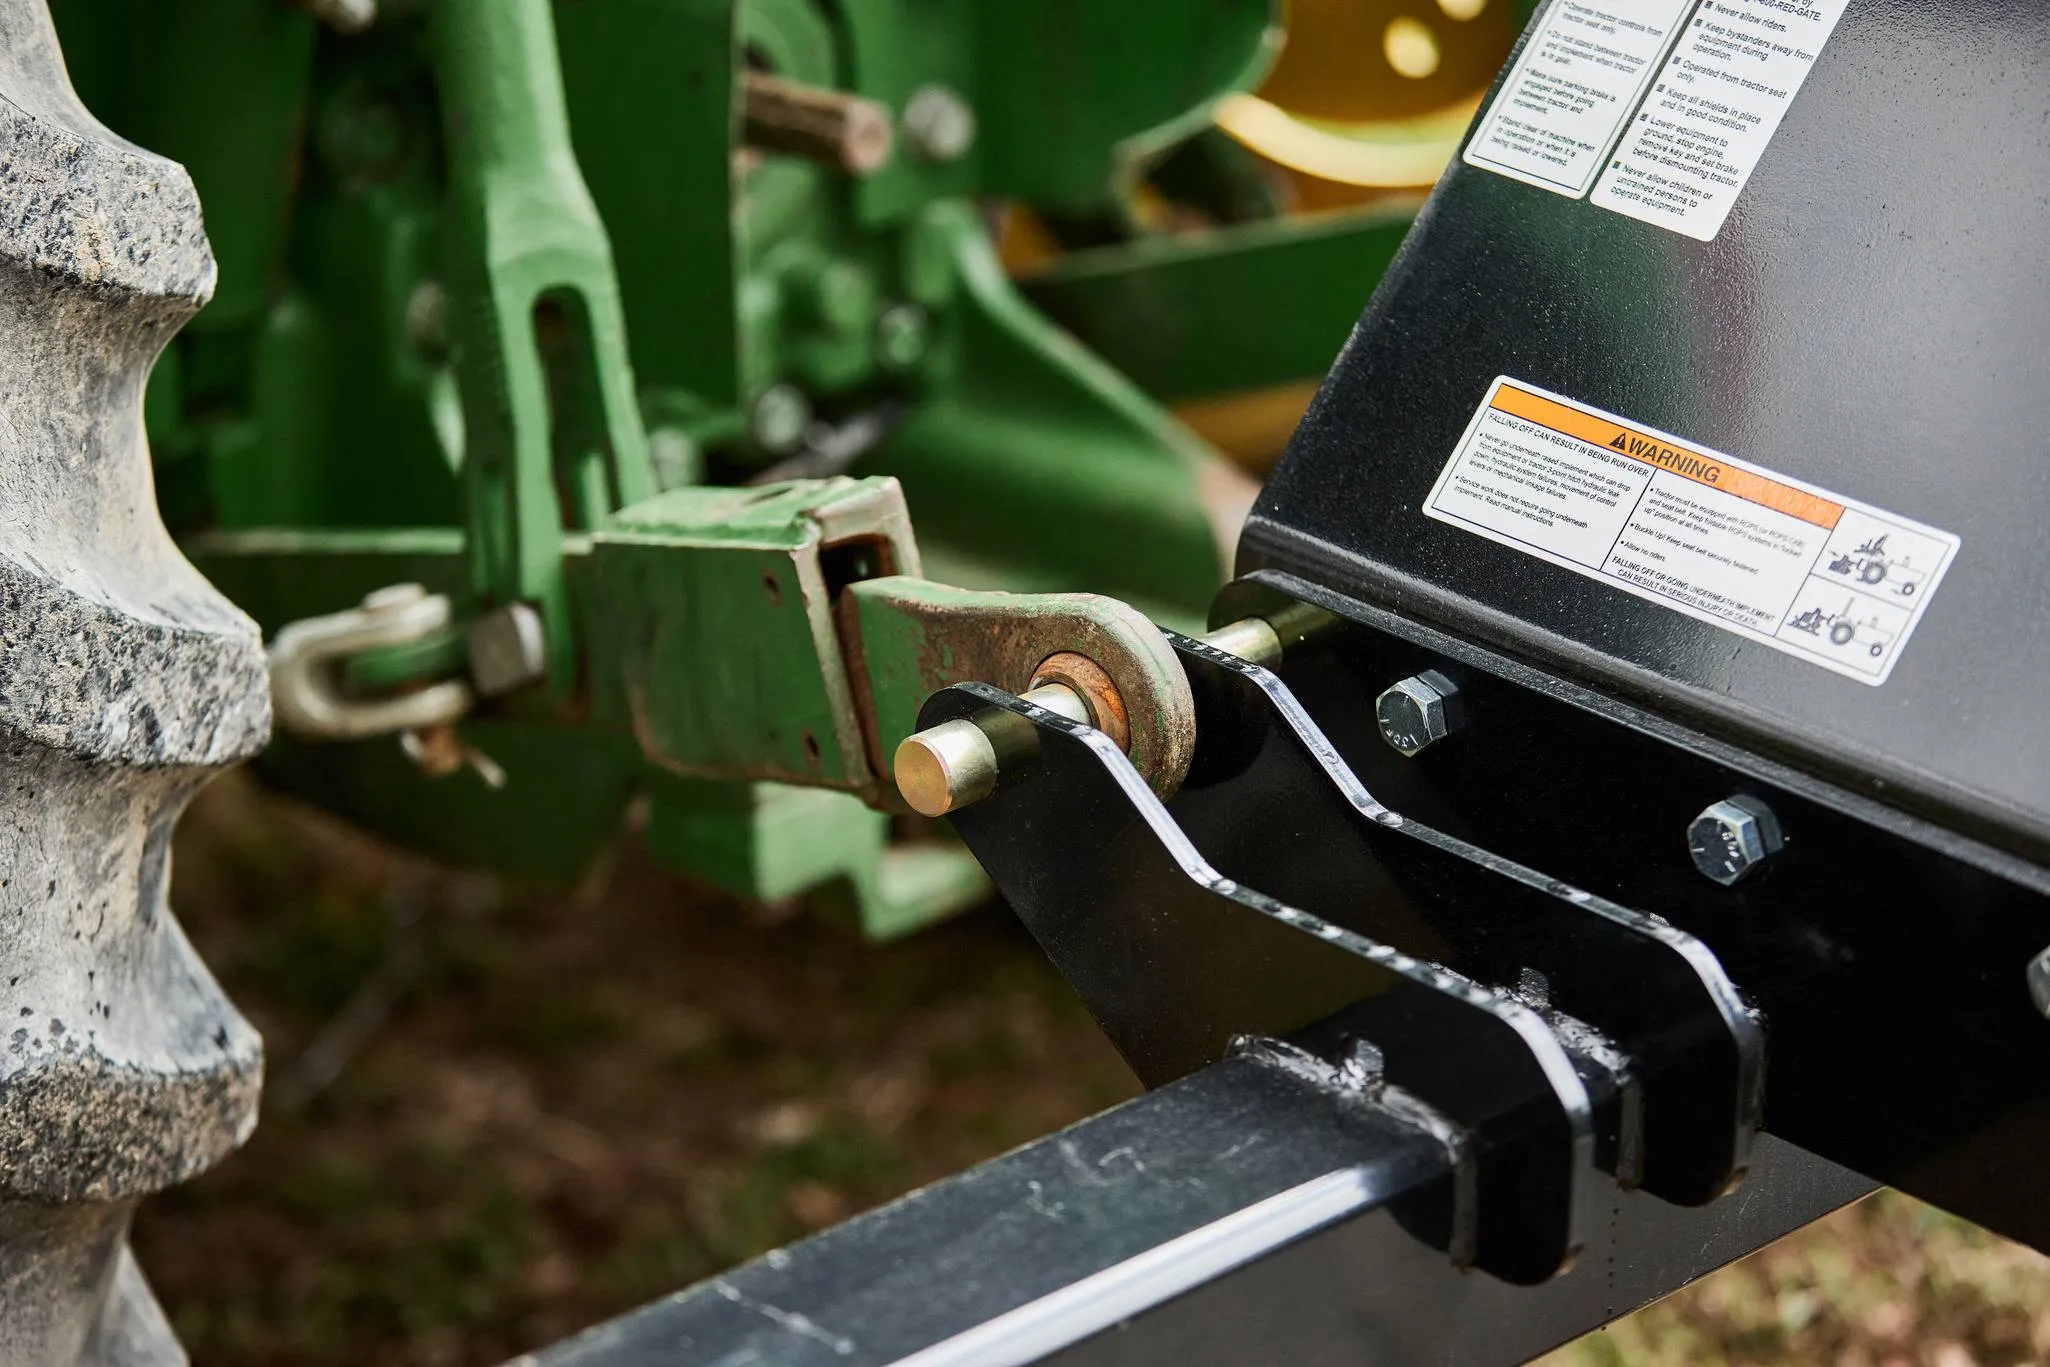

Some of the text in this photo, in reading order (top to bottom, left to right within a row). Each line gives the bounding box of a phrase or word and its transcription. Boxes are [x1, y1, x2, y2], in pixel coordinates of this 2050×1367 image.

[1714, 3, 1786, 32] Never allow riders.
[1692, 44, 1731, 61] operation.
[1698, 33, 1769, 62] equipment during
[1704, 21, 1814, 61] Keep bystanders away from
[1676, 71, 1695, 84] only.
[1682, 60, 1787, 99] Operated from tractor seat
[1659, 99, 1747, 132] and in good condition.
[1666, 88, 1761, 124] Keep all shields in place
[1643, 128, 1724, 160] ground, stop engine,
[1649, 116, 1728, 147] Lower equipment to
[1632, 147, 1738, 188] before dismounting tractor.
[1638, 138, 1739, 175] remove key and set brake
[1616, 176, 1698, 208] untrained persons to
[1622, 164, 1713, 200] Never allow children or
[1610, 186, 1685, 216] operate equipment.
[1483, 432, 1501, 443] Never
[1509, 443, 1541, 458] underneath
[1540, 454, 1559, 465] raised
[1558, 461, 1589, 476] implement
[1588, 472, 1605, 482] which
[1605, 478, 1617, 486] can
[1616, 482, 1631, 492] drop
[1488, 413, 1649, 477] FALLING OFF CAN RESULT IN BEING RUN OVER.
[1628, 440, 1720, 482] WARNING
[1469, 459, 1486, 470] levers
[1493, 468, 1525, 484] mechanical
[1524, 479, 1545, 492] linkage
[1478, 441, 1492, 451] from
[1491, 447, 1522, 462] equipment
[1528, 460, 1547, 471] tractor
[1546, 466, 1567, 479] 3-point
[1566, 474, 1581, 484] hitch
[1581, 479, 1607, 494] hydraulic
[1606, 488, 1620, 498] leak
[1491, 456, 1517, 471] hydraulic
[1516, 467, 1537, 478] system
[1559, 482, 1590, 497] movement
[1596, 496, 1617, 507] control
[1459, 476, 1588, 528] Service work does not require going underneath
[1484, 495, 1501, 507] Read
[1500, 503, 1522, 514] manual
[1648, 498, 1662, 506] and
[1660, 502, 1675, 511] seat
[1674, 506, 1687, 516] belt.
[1687, 511, 1704, 523] Keep
[1653, 511, 1678, 523] position
[1654, 487, 1675, 500] Tractor
[1674, 497, 1691, 506] must
[1689, 501, 1699, 510] be
[1698, 506, 1727, 519] equipped
[1726, 516, 1739, 524] with
[1623, 541, 1641, 552] Allow
[1640, 548, 1649, 556] no
[1634, 523, 1654, 536] Buckle
[1665, 535, 1682, 547] Keep
[1681, 542, 1696, 551] seat
[1695, 546, 1708, 555] belt
[1611, 555, 1641, 572] FALLING
[1640, 566, 1656, 577] OFF
[1655, 572, 1667, 581] OR
[1666, 576, 1689, 590] GOING
[1689, 586, 1735, 605] UNDERNEATH
[1617, 568, 1633, 580] CAN
[1632, 574, 1660, 589] RESULT
[1658, 584, 1668, 592] IN
[1667, 587, 1697, 604] SERIOUS
[1697, 599, 1723, 612] INJURY
[1722, 608, 1734, 616] OR
